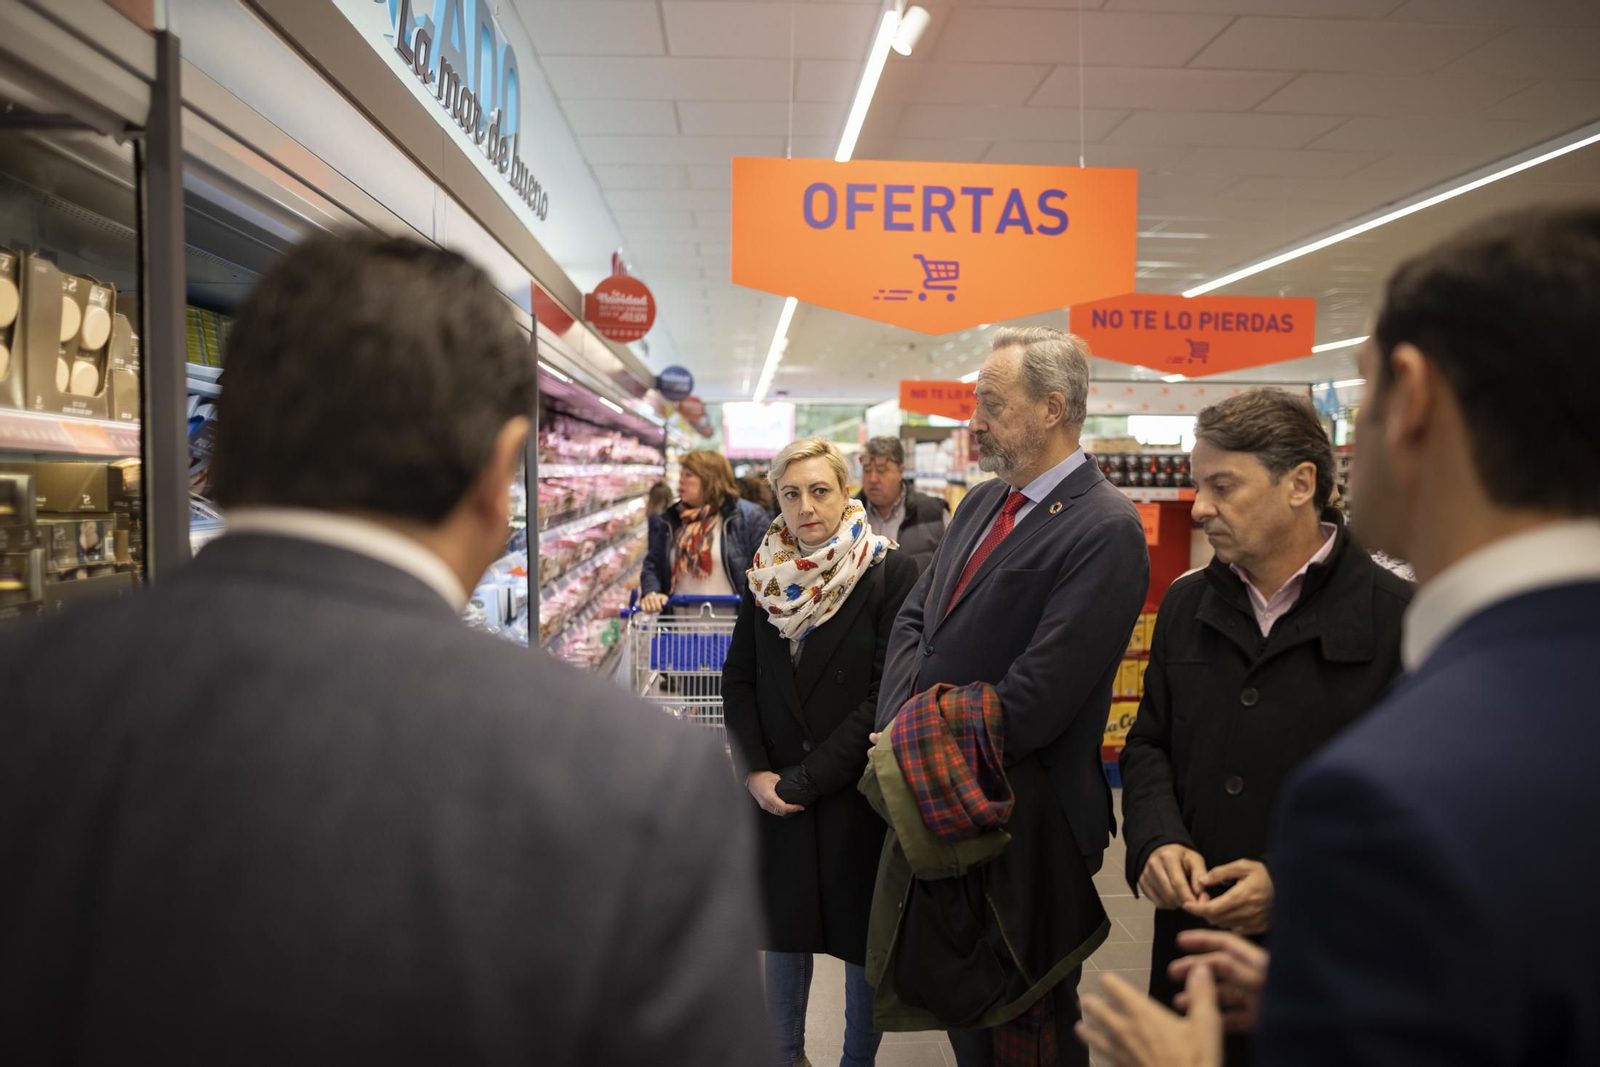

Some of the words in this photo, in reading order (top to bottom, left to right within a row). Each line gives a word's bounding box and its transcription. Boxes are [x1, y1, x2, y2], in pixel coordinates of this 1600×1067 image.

[393, 0, 433, 84] La
[433, 55, 484, 145] mar
[487, 107, 509, 174] de
[508, 132, 548, 221] bueno
[803, 182, 1069, 236] OFERTAS
[1091, 309, 1123, 329] NO
[1129, 310, 1157, 330] TE
[1164, 311, 1192, 331] LO
[1199, 312, 1294, 333] PIERDAS
[910, 389, 927, 400] NO
[931, 389, 944, 400] TE
